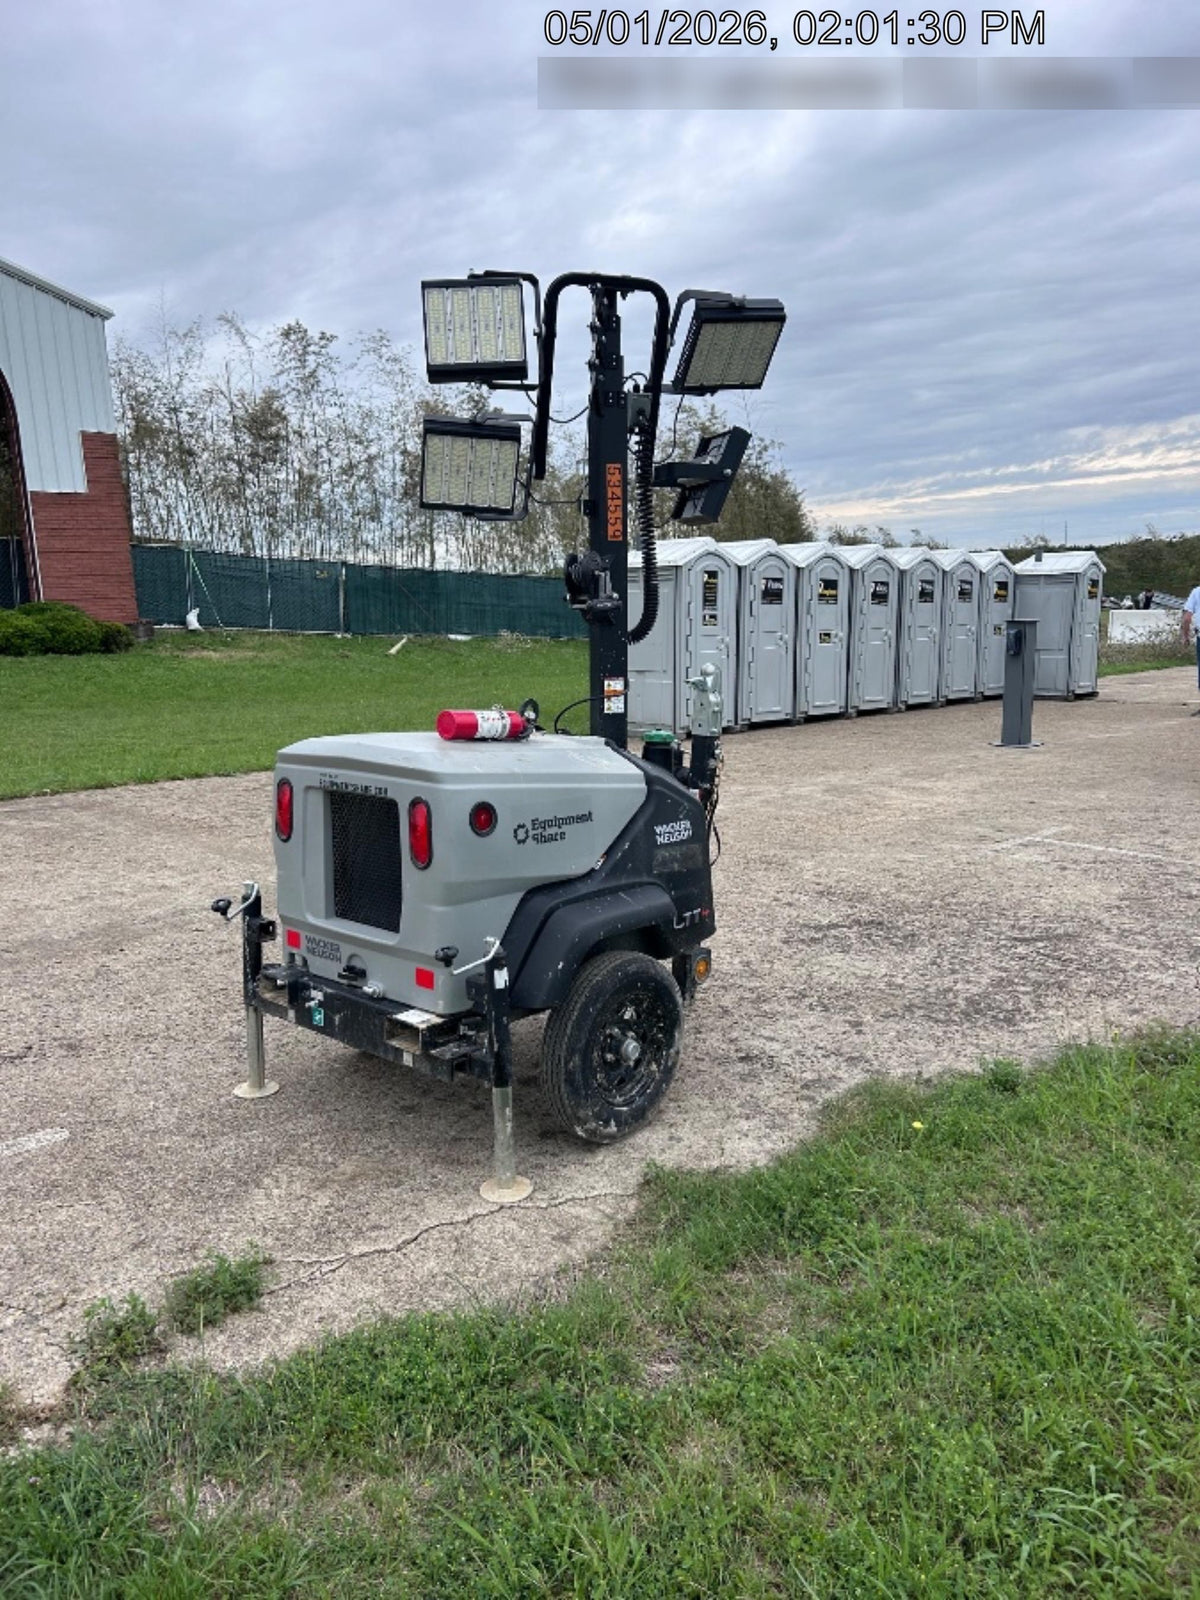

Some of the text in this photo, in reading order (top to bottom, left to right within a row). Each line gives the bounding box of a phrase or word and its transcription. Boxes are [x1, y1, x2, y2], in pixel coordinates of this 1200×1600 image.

[607, 466, 622, 539] 534559
[530, 811, 593, 831] Equipment
[656, 830, 692, 845] NEUSON
